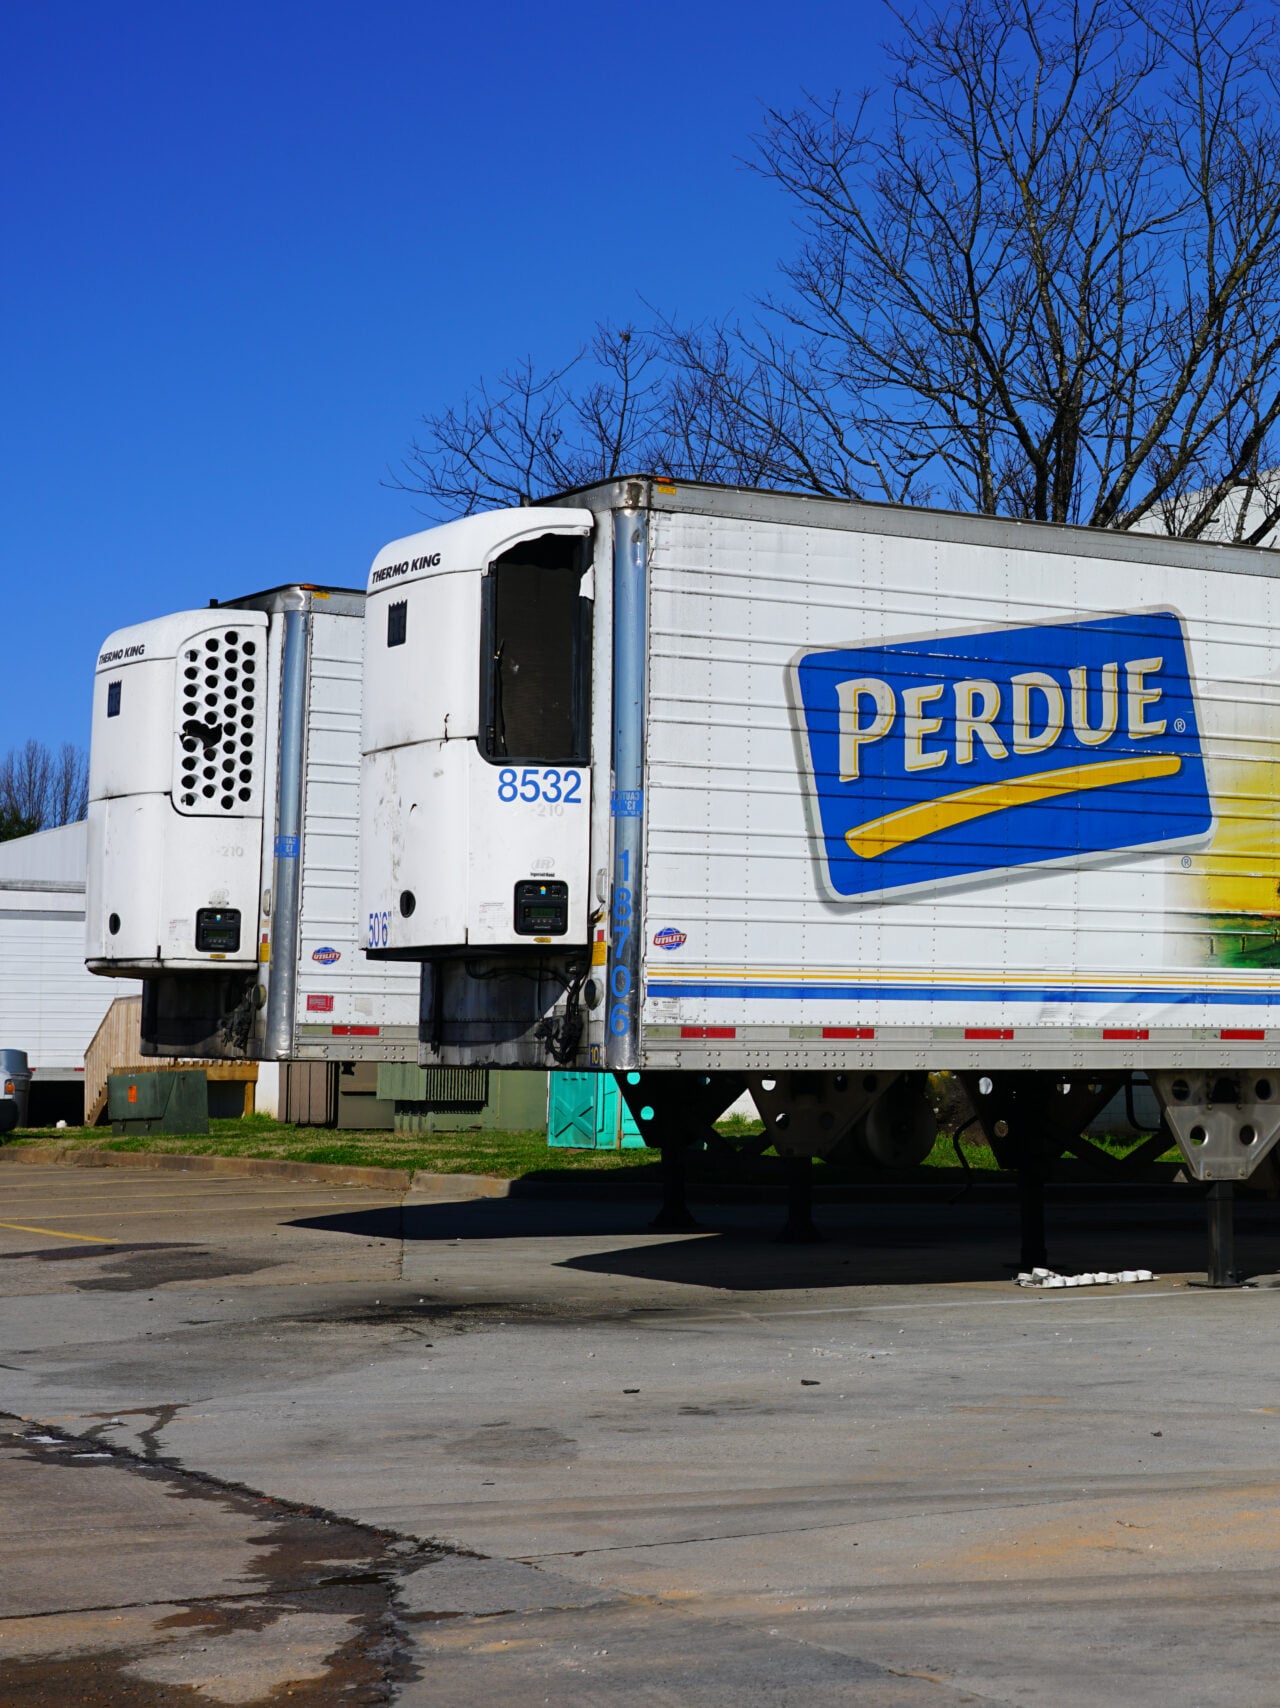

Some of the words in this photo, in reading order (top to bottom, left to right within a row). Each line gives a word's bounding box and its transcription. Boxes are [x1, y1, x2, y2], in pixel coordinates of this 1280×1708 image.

[372, 560, 409, 584] THERMO
[410, 553, 441, 572] KING
[99, 648, 123, 665] THERMO
[124, 644, 145, 658] KING
[835, 656, 1167, 783] PERDUE
[497, 768, 582, 804] 8532
[368, 910, 392, 948] 50'6"
[610, 849, 632, 1037] 18706
[655, 934, 685, 944] UTILITY
[591, 1046, 600, 1065] 10
